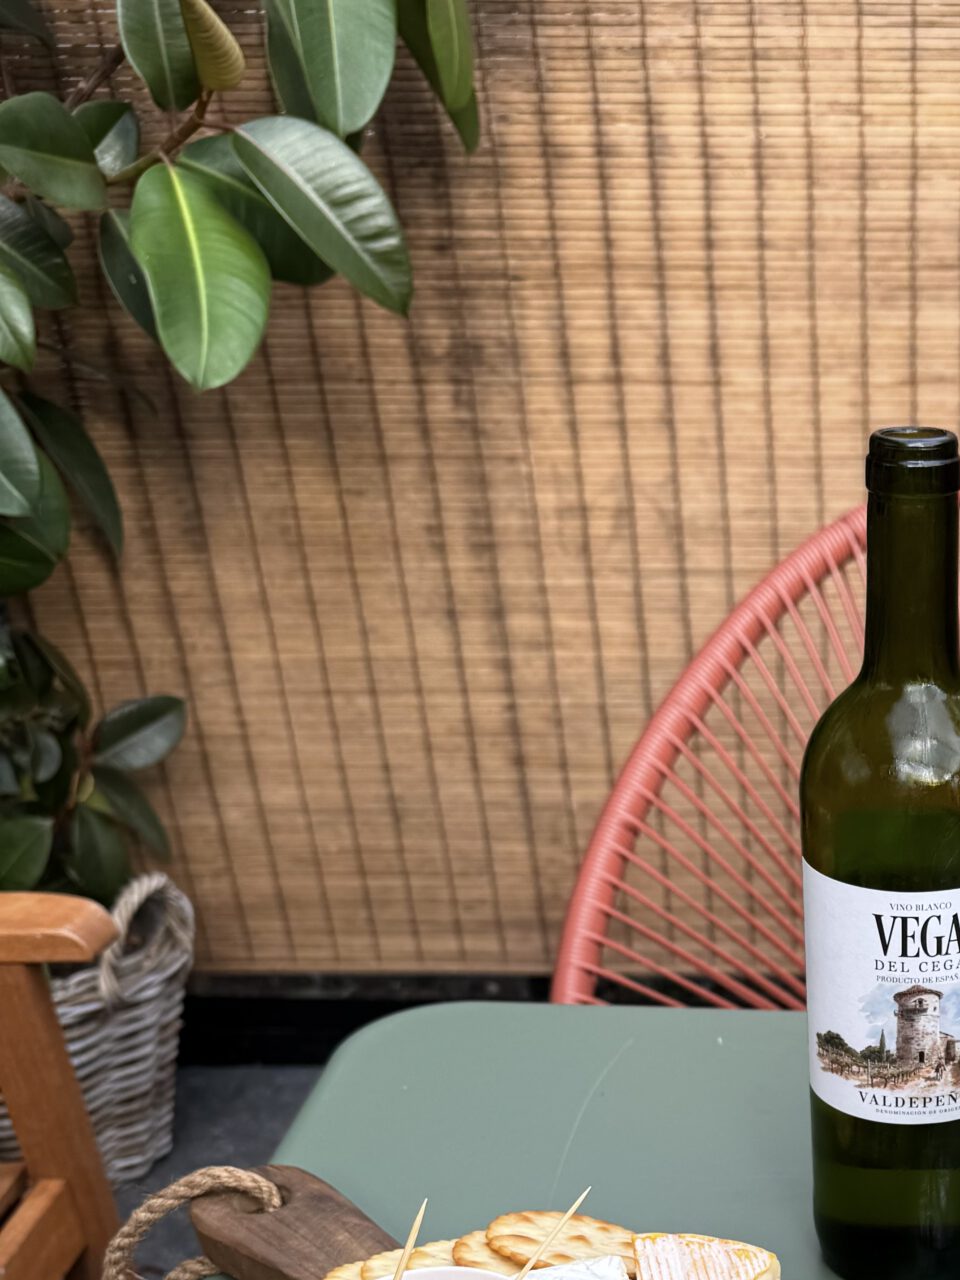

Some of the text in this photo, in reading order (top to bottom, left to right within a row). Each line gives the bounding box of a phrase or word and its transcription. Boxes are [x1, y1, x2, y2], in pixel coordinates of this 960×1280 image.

[889, 902, 952, 911] VINO BLANCO
[875, 959, 910, 973] DEL
[876, 975, 920, 984] PRODUCTO
